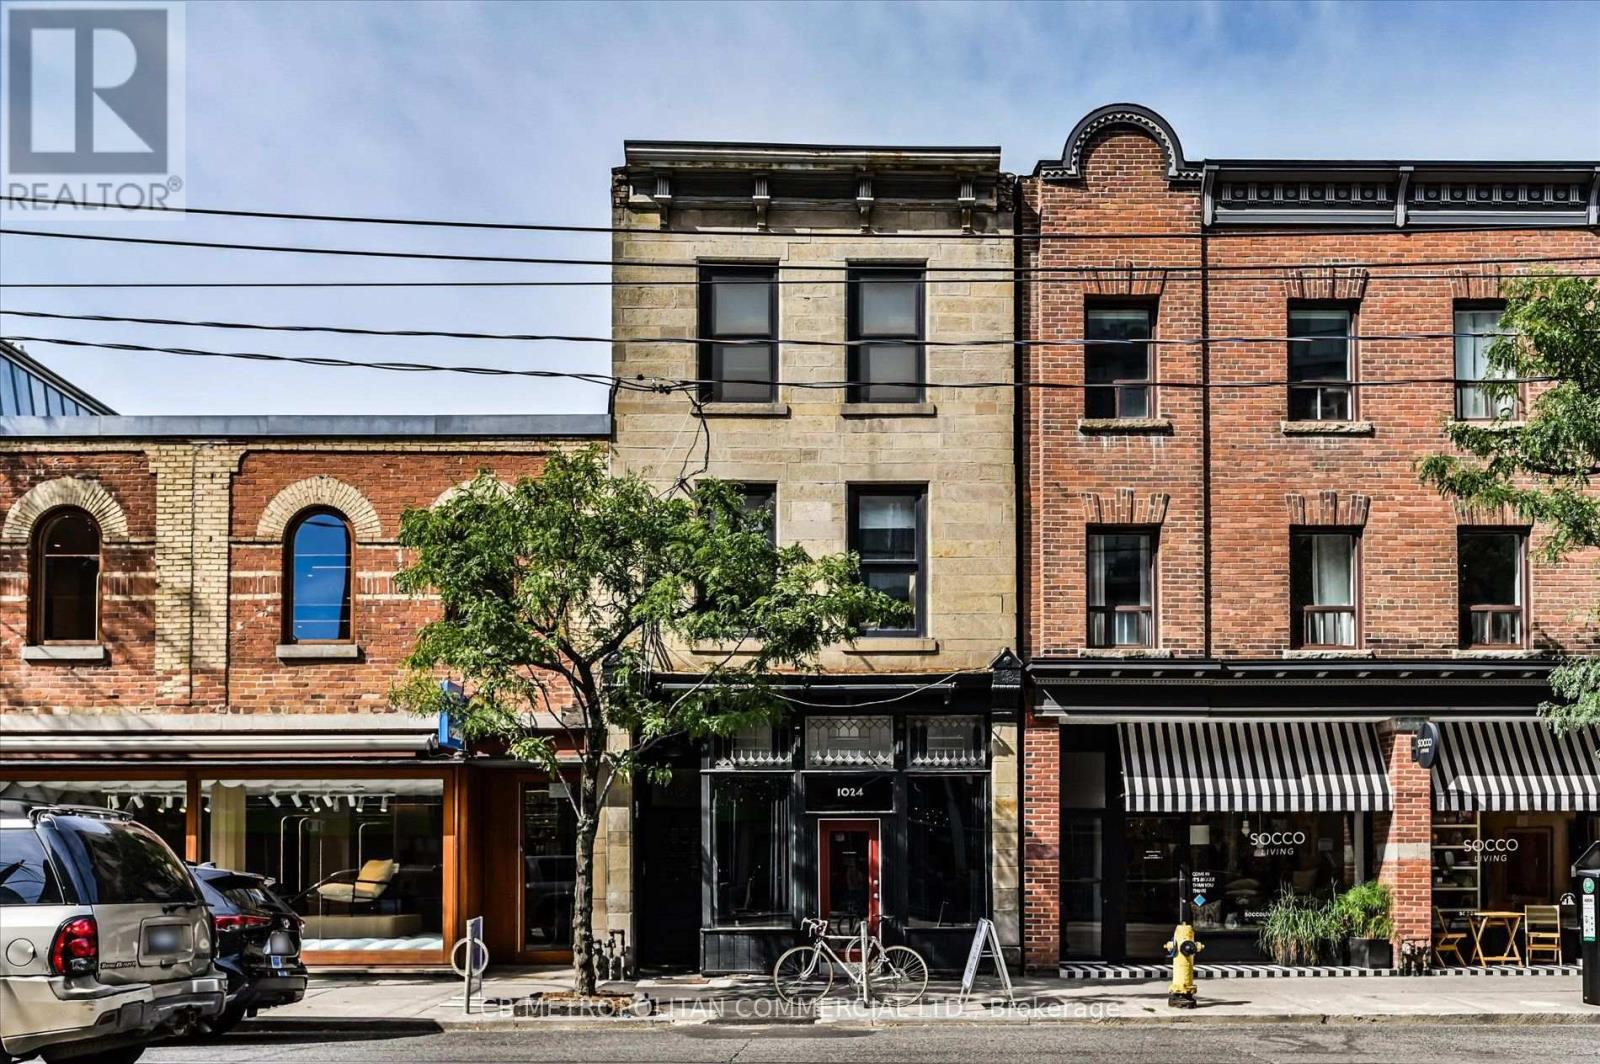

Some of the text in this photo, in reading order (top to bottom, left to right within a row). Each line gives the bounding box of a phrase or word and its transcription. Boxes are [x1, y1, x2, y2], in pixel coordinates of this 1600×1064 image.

[837, 787, 864, 797] 1024
[1250, 831, 1306, 846] SOCCO
[1463, 838, 1519, 852] SOCCO
